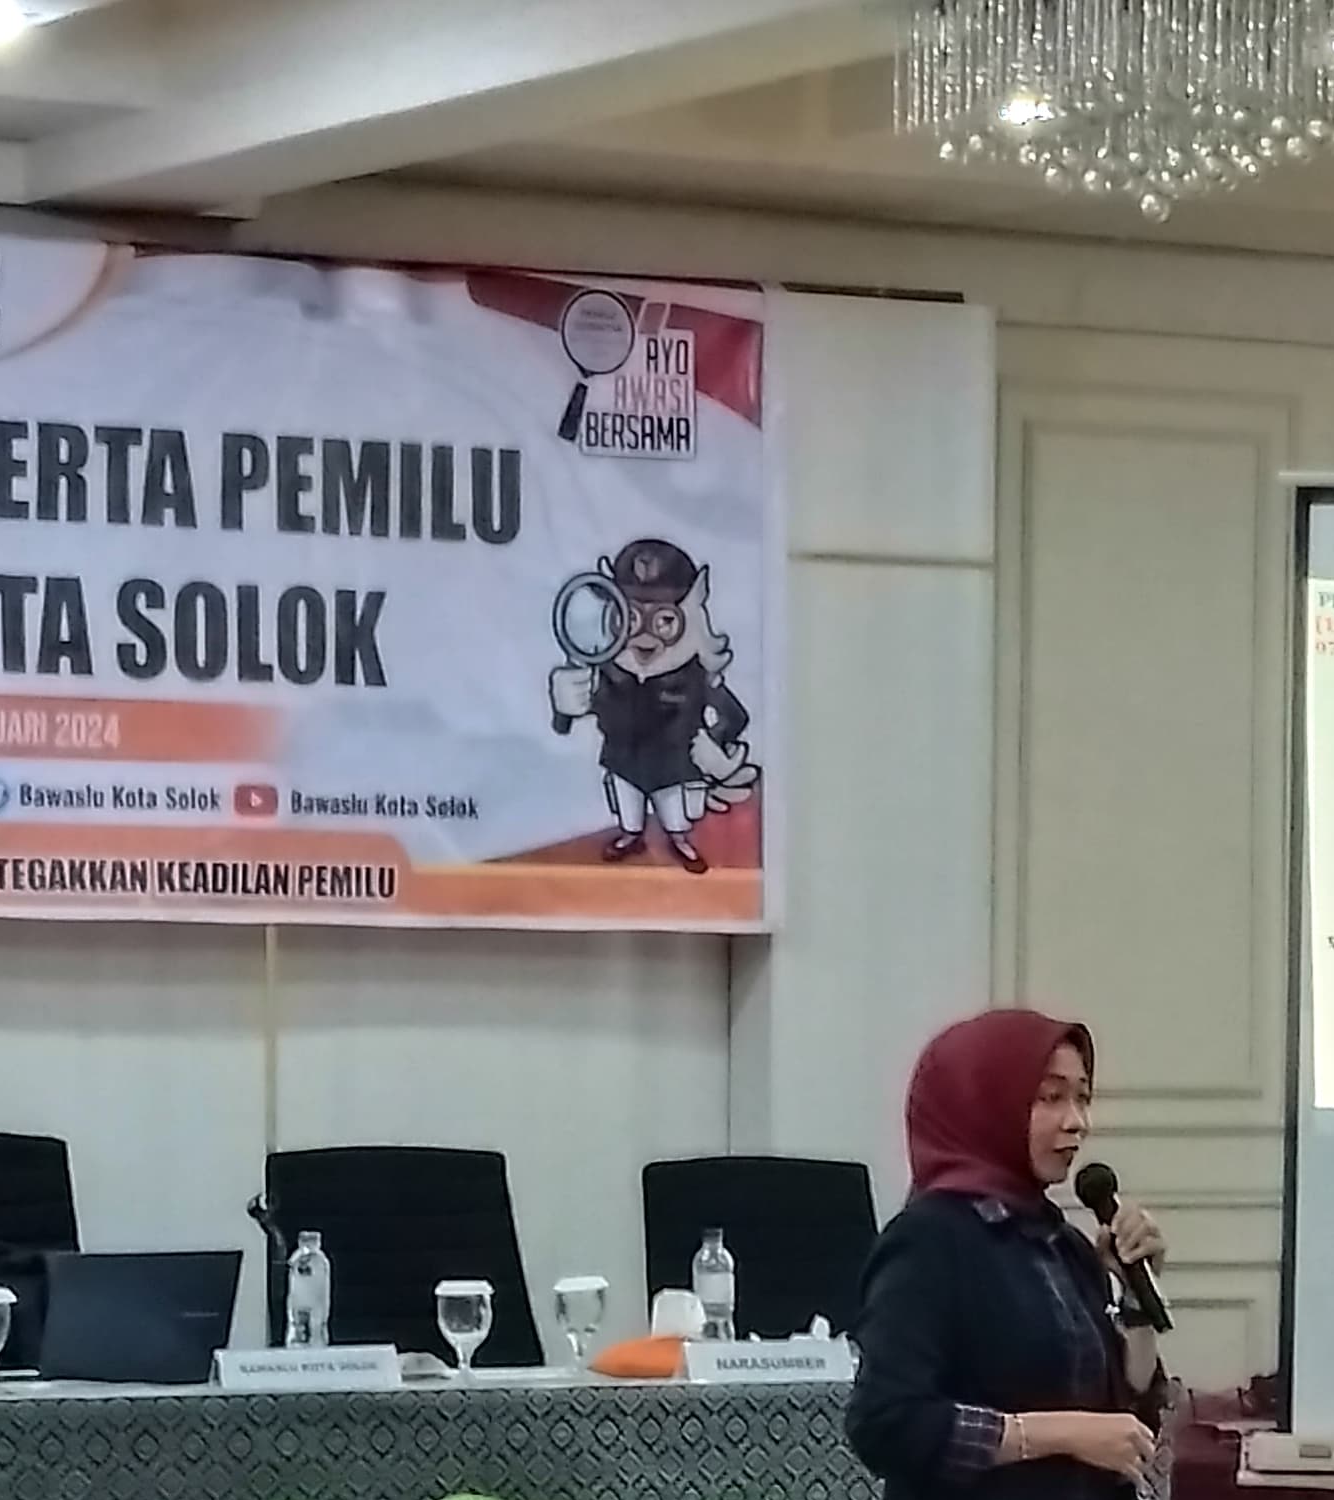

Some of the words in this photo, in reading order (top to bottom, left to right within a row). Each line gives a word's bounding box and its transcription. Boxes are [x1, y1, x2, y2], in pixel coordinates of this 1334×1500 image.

[647, 338, 689, 375] AYO
[614, 376, 689, 414] AWASI
[585, 411, 691, 452] BERSAMA
[220, 432, 522, 545] PEMILU
[115, 578, 388, 687] SOLOK
[55, 713, 121, 748] 2024
[19, 783, 105, 809] Bawaslu
[112, 785, 159, 809] Kota
[165, 785, 221, 812] Solok
[291, 790, 368, 816] Bawaslu
[375, 793, 419, 818] Kota
[425, 794, 479, 820] Solok
[157, 858, 290, 897] KEADILAN
[298, 864, 397, 899] PEMILU
[715, 1356, 827, 1371] NARASUMBER
